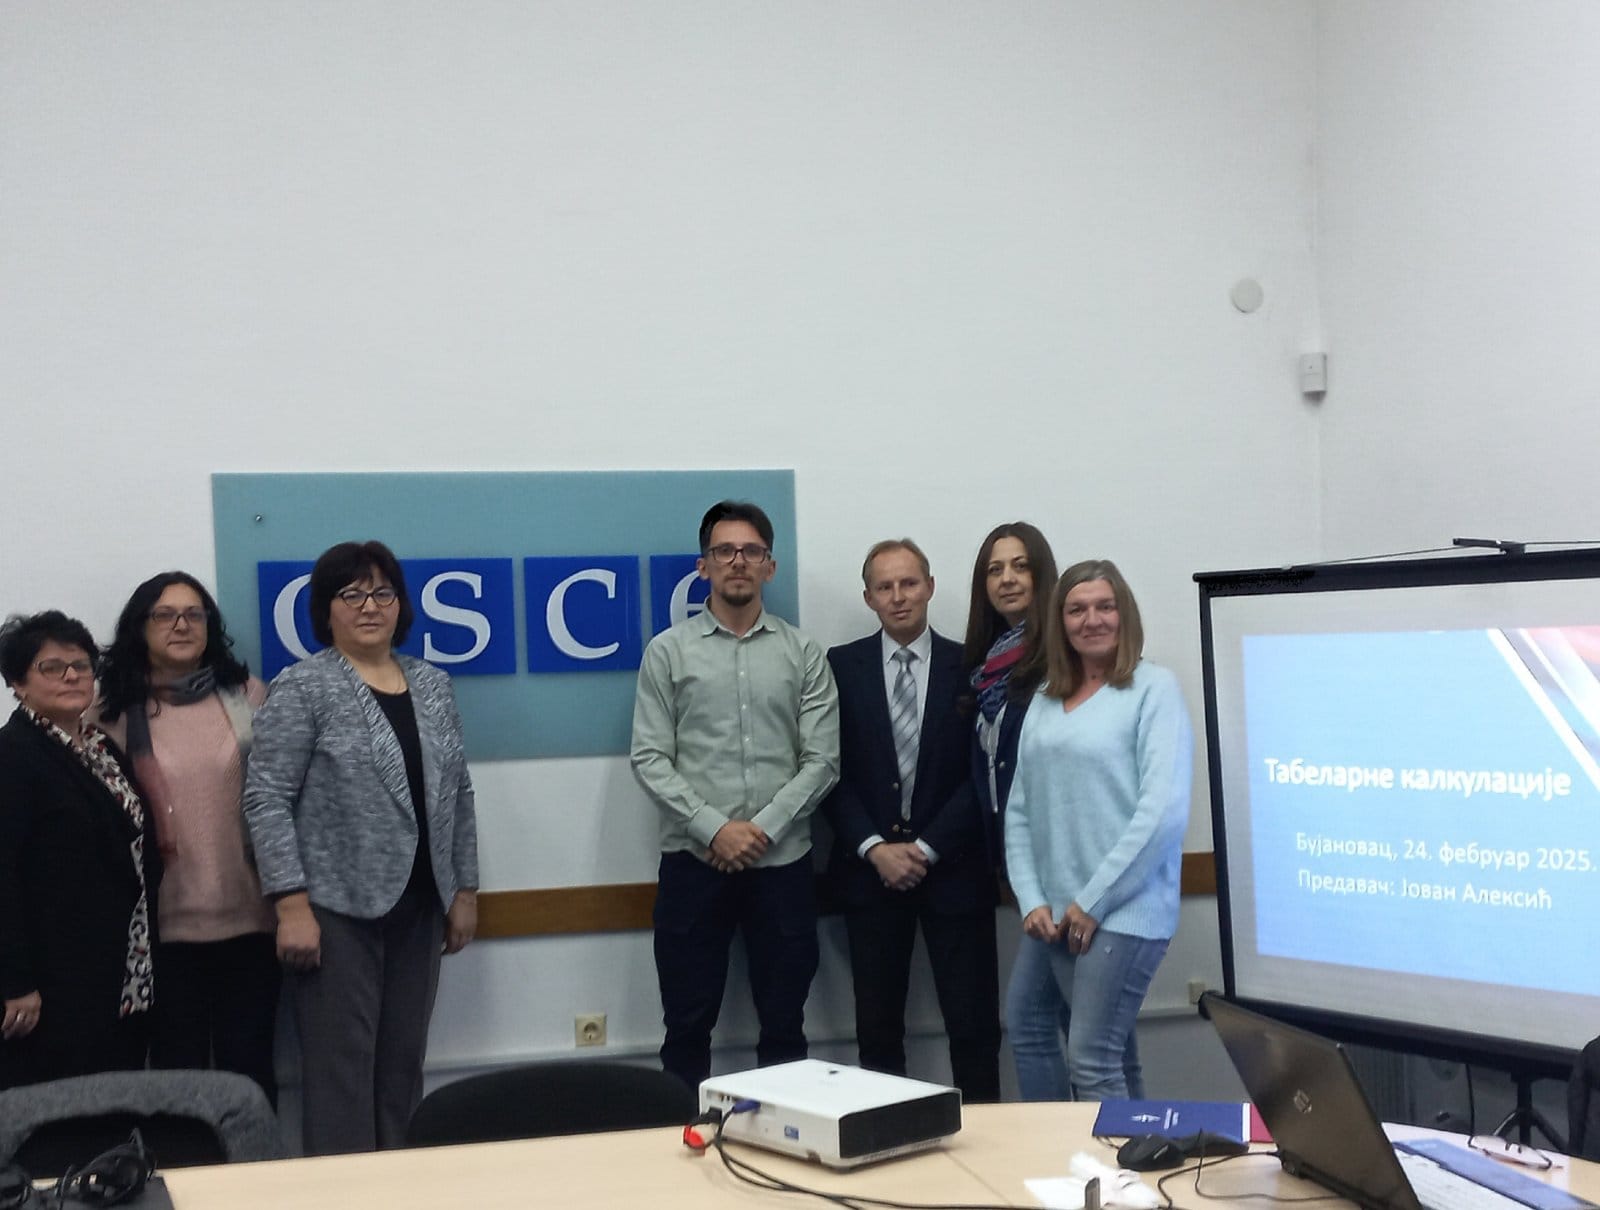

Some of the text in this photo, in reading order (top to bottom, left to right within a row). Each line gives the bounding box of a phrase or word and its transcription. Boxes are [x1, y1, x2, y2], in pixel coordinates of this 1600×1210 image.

[1264, 757, 1572, 802] Табеларне калкулације
[1296, 832, 1598, 873] Бујановац, 24. фебруар 2025.
[1298, 869, 1553, 910] Предавач: Јован Алексић
